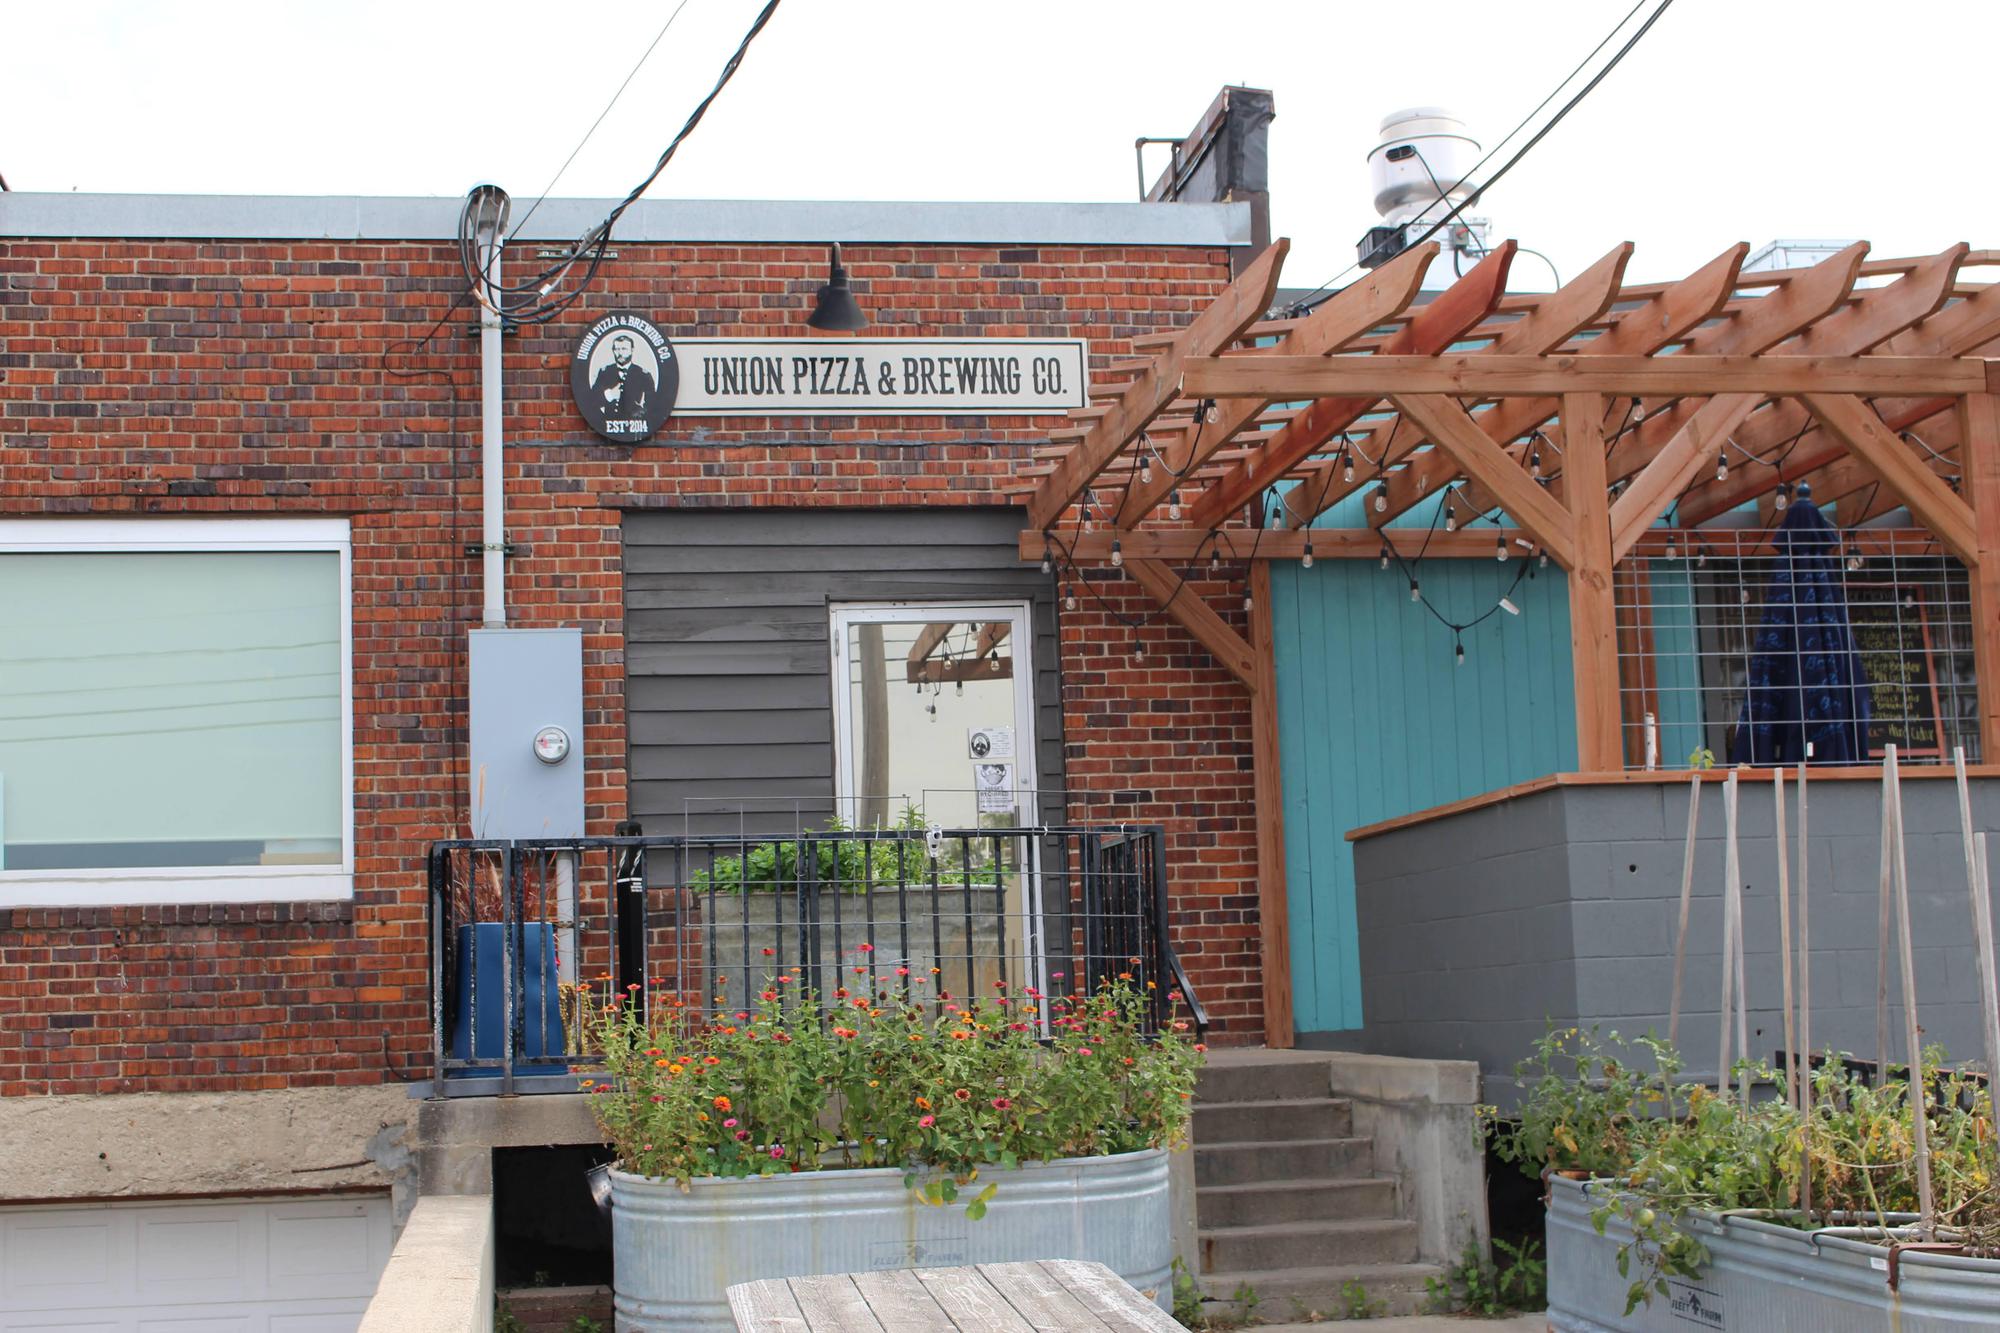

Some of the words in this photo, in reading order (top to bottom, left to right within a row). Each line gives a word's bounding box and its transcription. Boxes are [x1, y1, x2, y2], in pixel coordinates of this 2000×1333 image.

[577, 332, 598, 361] UNION
[593, 316, 619, 337] PIZZA
[620, 316, 627, 325] &
[628, 315, 665, 347] BREWING
[657, 346, 671, 363] CO.
[703, 356, 784, 395] UNION
[792, 356, 870, 395] PIZZA
[878, 361, 897, 395] &
[903, 357, 1021, 395] BREWING
[1032, 357, 1068, 395] CO.
[630, 420, 648, 433] 2014
[1671, 1299, 1690, 1312] FLEET
